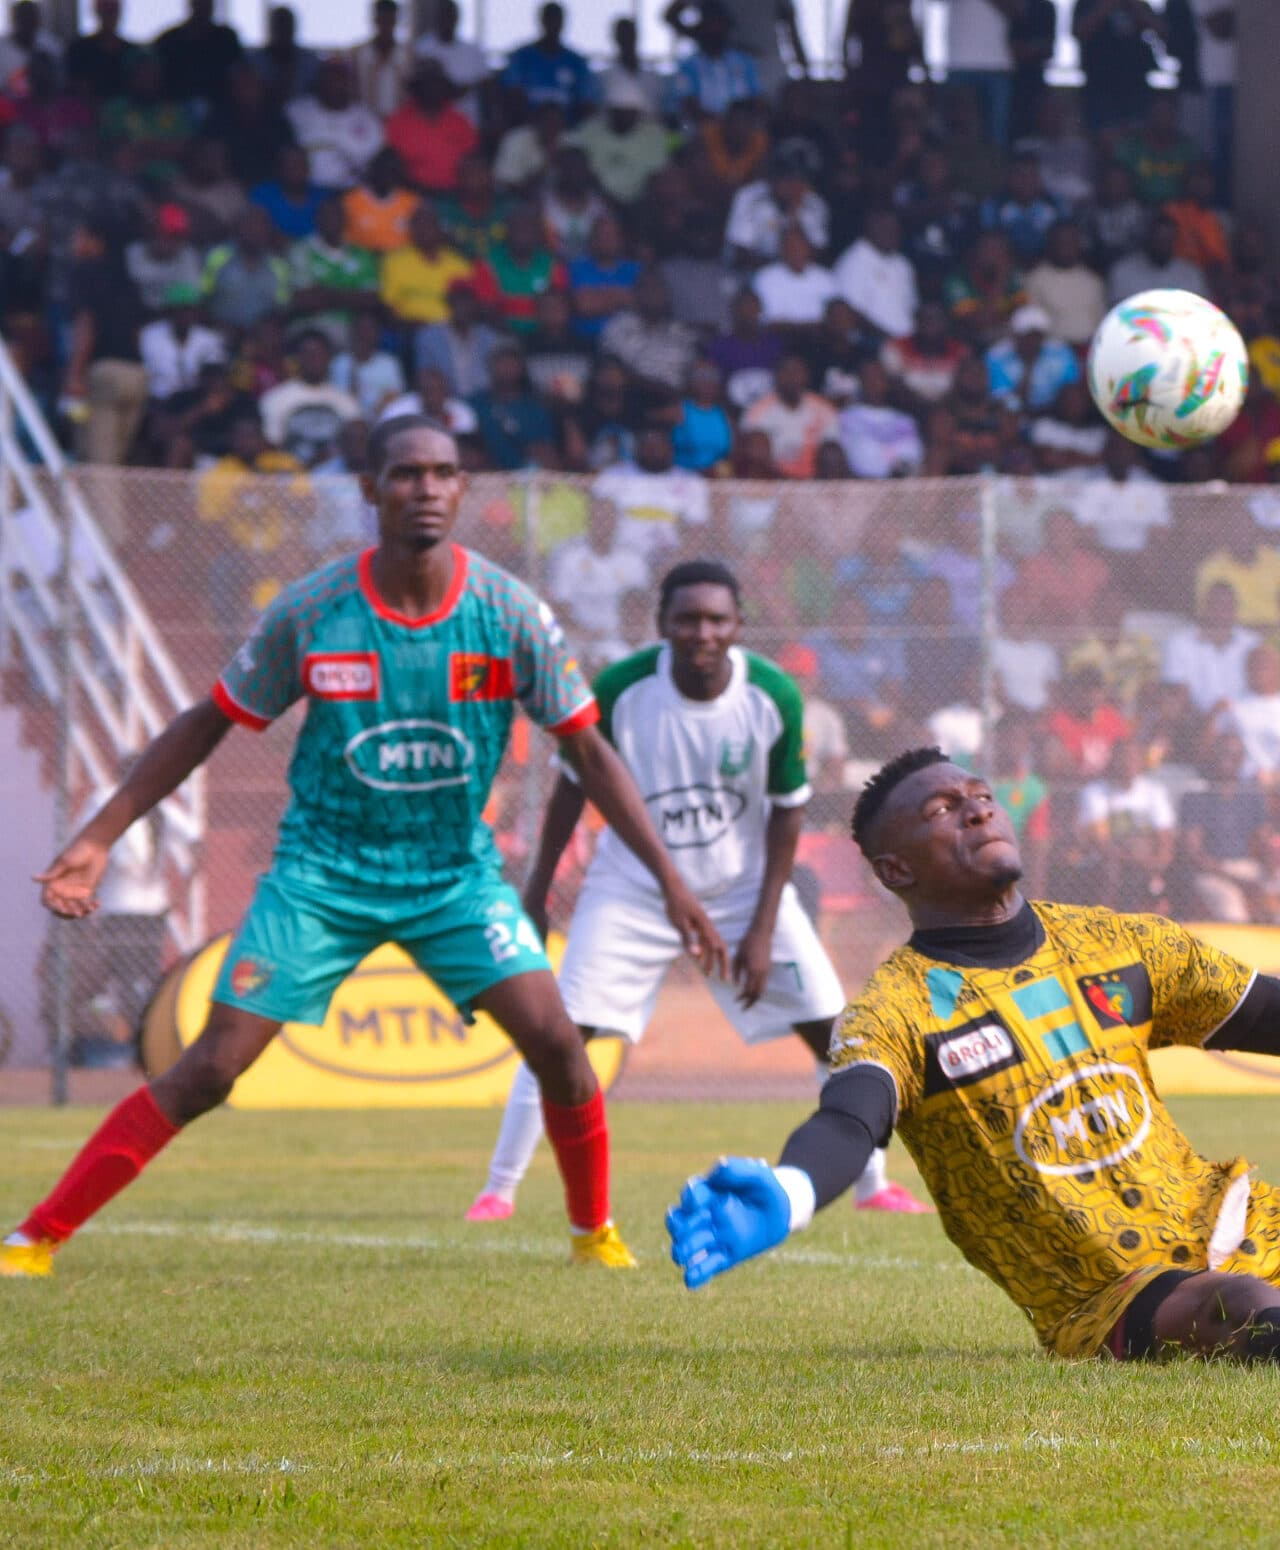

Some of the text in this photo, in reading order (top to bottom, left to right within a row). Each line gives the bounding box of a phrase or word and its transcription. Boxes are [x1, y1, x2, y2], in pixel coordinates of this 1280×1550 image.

[378, 743, 455, 771] MTN
[663, 802, 724, 830] MTN
[484, 920, 543, 962] 24
[337, 1007, 466, 1046] MTN
[947, 1034, 1003, 1067] BROLI
[1049, 1090, 1131, 1150] MTN
